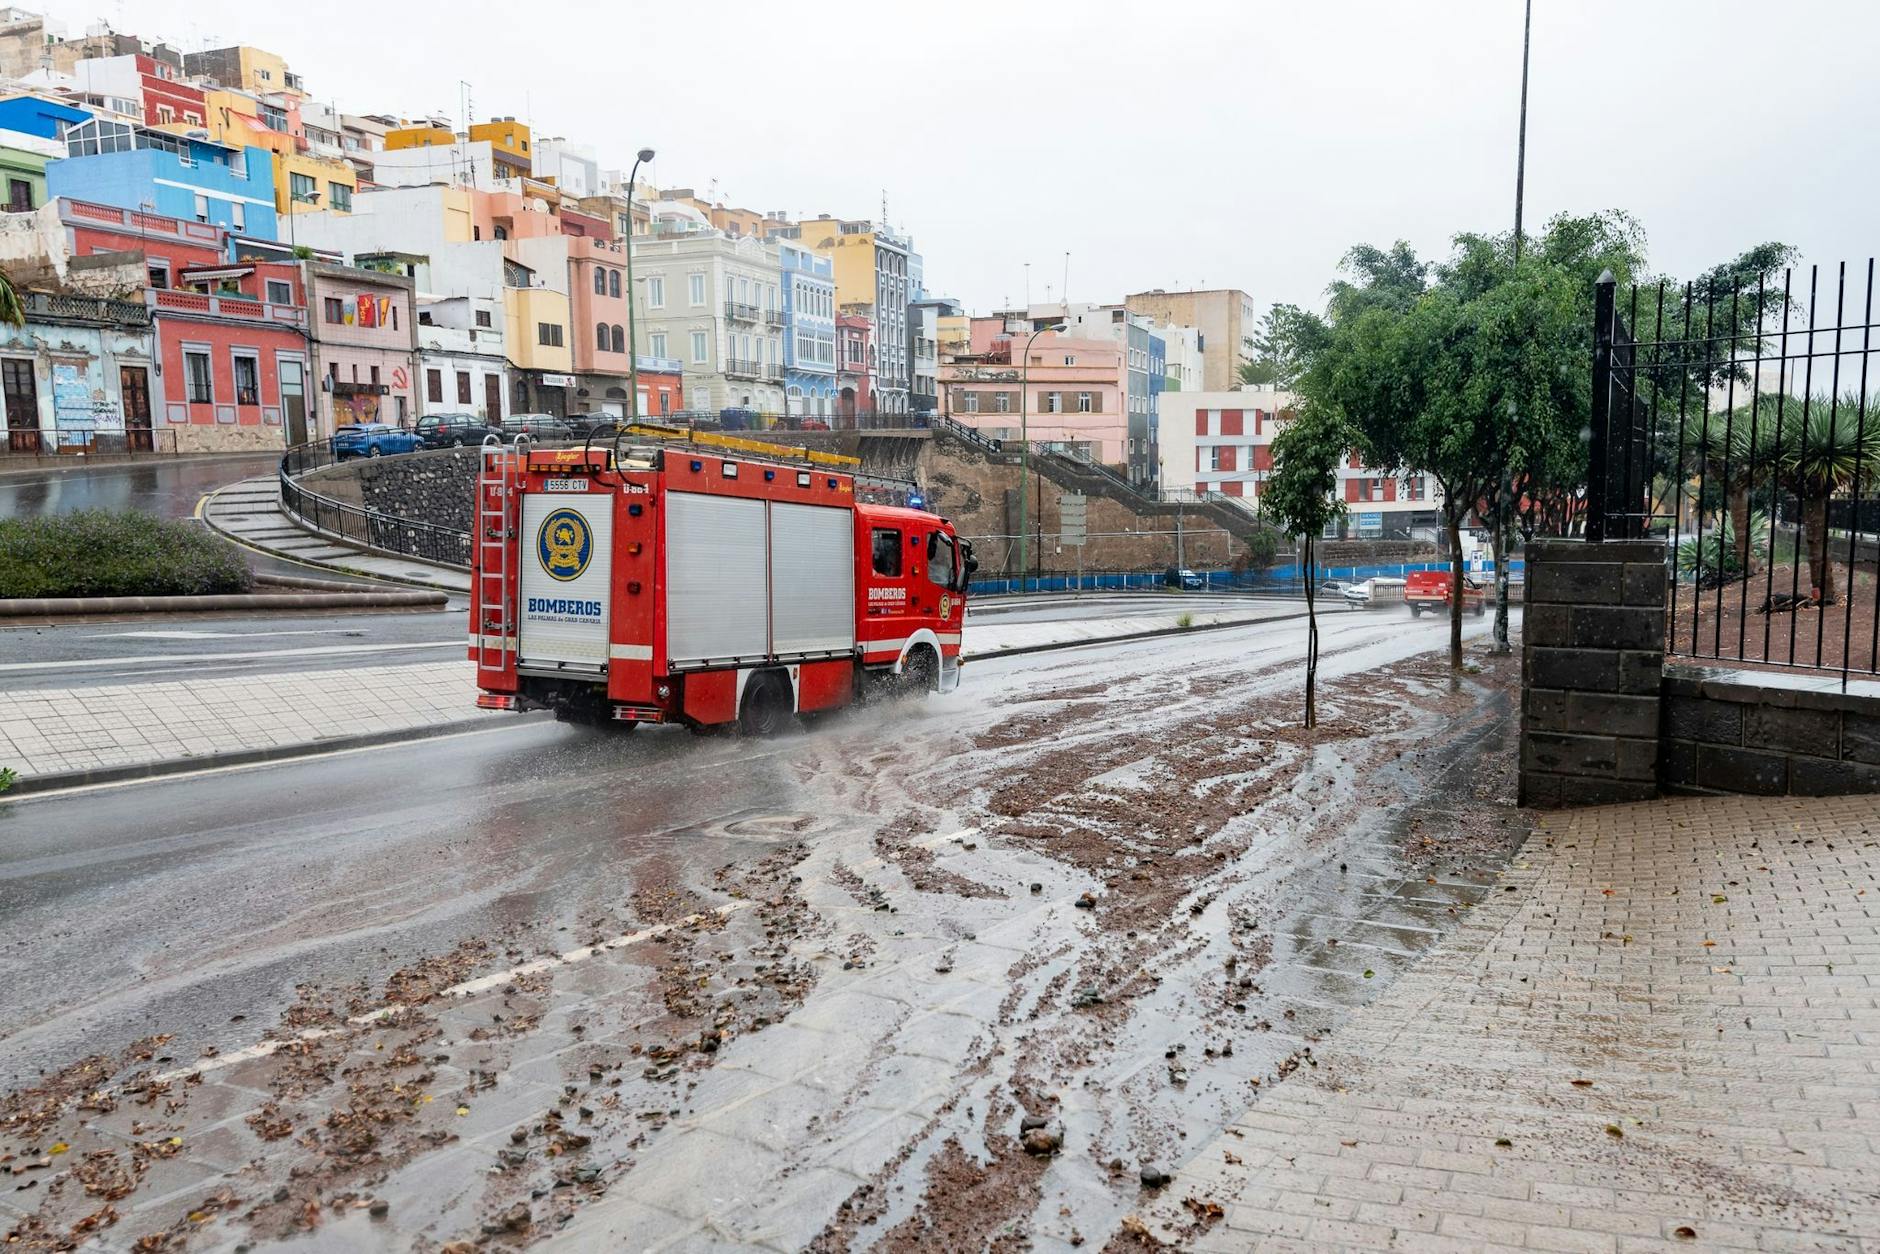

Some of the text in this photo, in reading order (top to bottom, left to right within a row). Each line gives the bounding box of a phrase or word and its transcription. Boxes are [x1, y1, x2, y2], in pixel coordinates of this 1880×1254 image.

[572, 480, 587, 490] CTV
[868, 587, 906, 600] BOMBEROS
[528, 598, 602, 616] BOMBEROS
